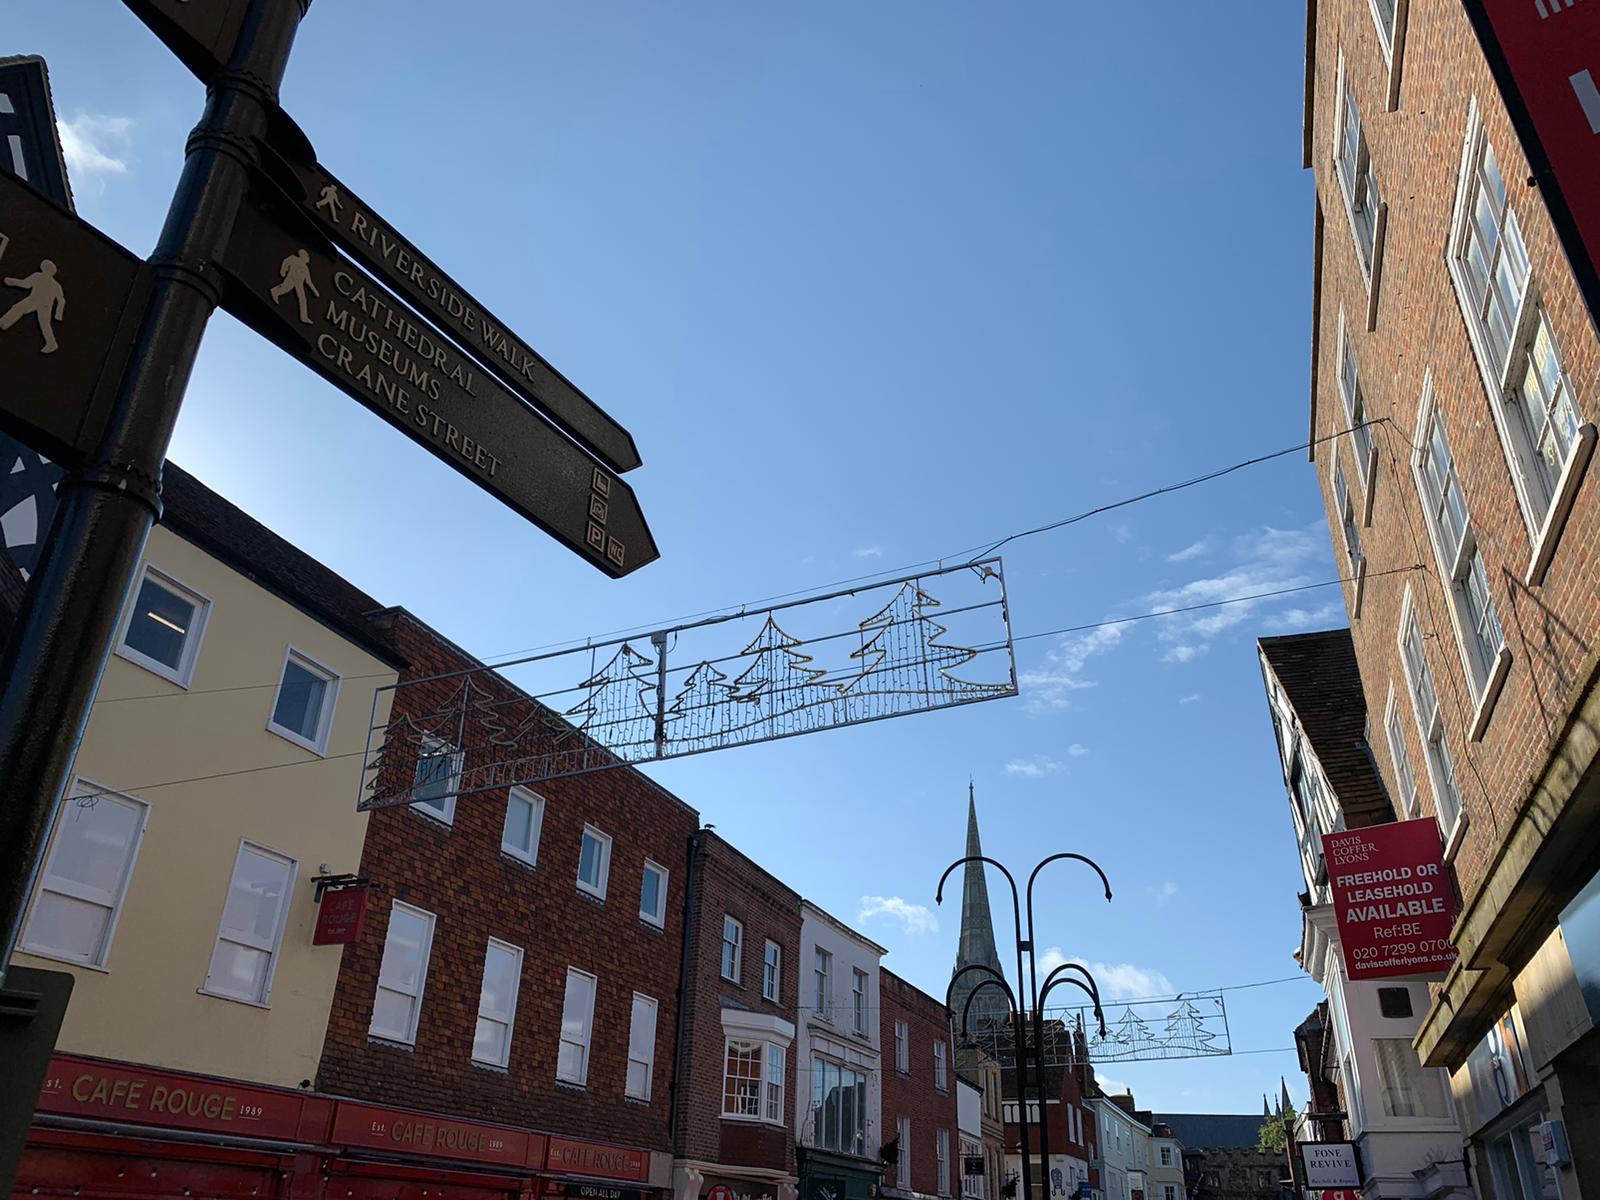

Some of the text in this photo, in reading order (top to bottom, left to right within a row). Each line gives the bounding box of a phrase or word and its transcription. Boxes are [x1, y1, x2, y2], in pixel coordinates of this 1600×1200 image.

[351, 211, 536, 382] RIVERSIDE WALK
[333, 271, 478, 397] CATHEDRAL
[325, 301, 440, 400] MUSEUMS
[317, 333, 502, 476] CRANE STREET
[609, 541, 623, 558] WC
[1331, 836, 1361, 849] DAVIS
[1332, 842, 1379, 857] COFFER
[1334, 853, 1369, 865] LYONS
[1336, 863, 1439, 888] FREEHOLD OR
[1347, 881, 1433, 903] LEASEHOLD
[1346, 898, 1446, 924] AVAILABLE
[1374, 922, 1422, 939] Ref:BE
[1353, 938, 1456, 960] 020 7299 0700
[1355, 951, 1459, 970] daviscofferlyons.co.uk
[149, 1086, 237, 1121] ROUGE
[239, 1105, 263, 1117] 1989
[435, 1127, 487, 1152] ROUGE
[594, 1151, 630, 1172] ROUGE
[1310, 1159, 1352, 1168] REVIVE
[1314, 1148, 1342, 1158] FONE
[580, 1186, 622, 1199] OPEN ALL DAY
